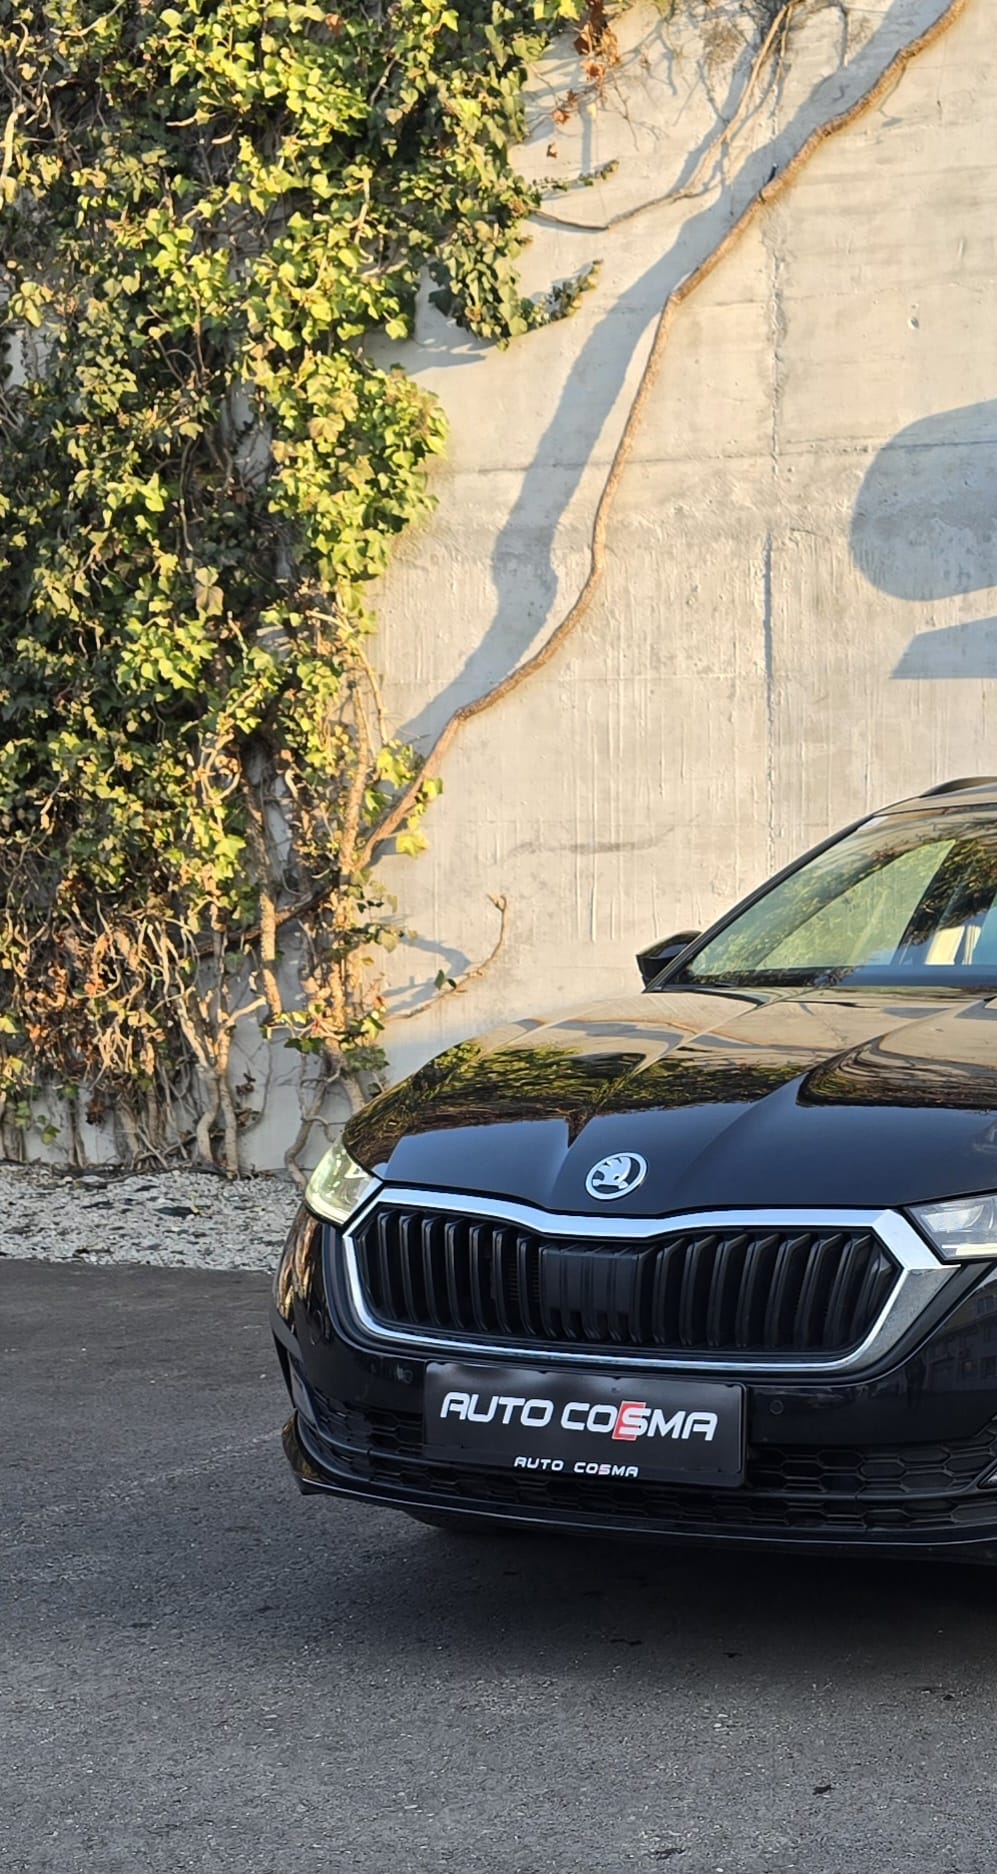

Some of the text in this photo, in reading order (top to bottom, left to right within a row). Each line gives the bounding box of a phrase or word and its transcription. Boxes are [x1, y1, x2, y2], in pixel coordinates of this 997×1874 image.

[440, 1391, 718, 1441] AUTO COSMA
[514, 1456, 639, 1478] AUTO COSMA
